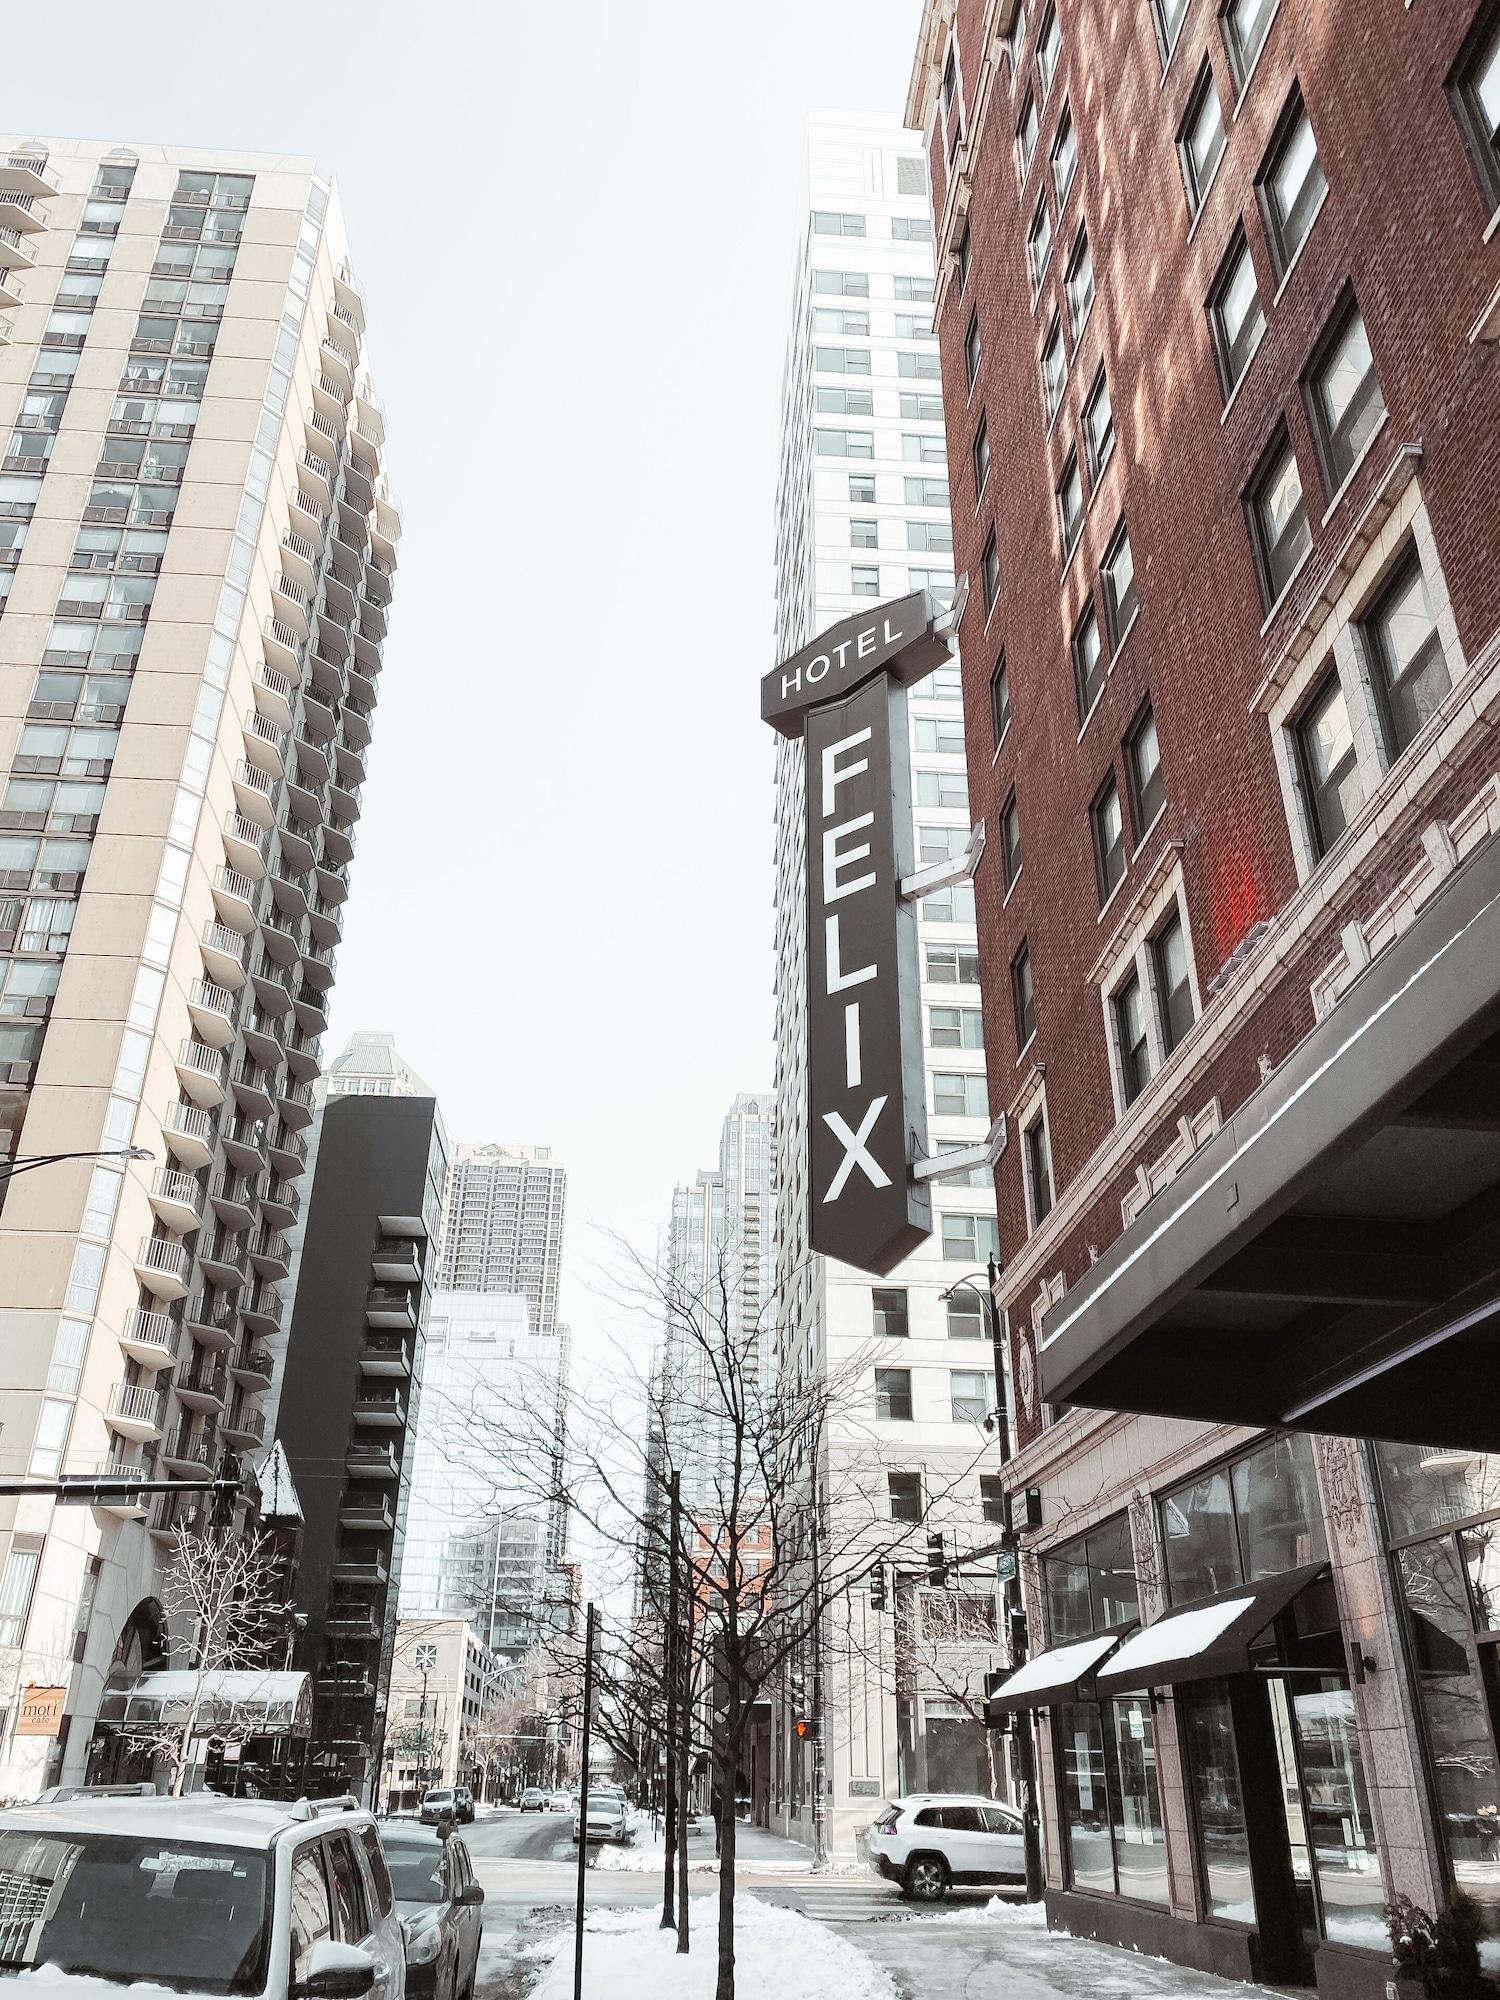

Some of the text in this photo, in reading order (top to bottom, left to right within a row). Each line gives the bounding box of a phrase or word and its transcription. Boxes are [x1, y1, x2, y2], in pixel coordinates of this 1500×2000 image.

[781, 618, 903, 699] HOTEL
[822, 726, 893, 1203] FELIX
[31, 1715, 50, 1724] cafe
